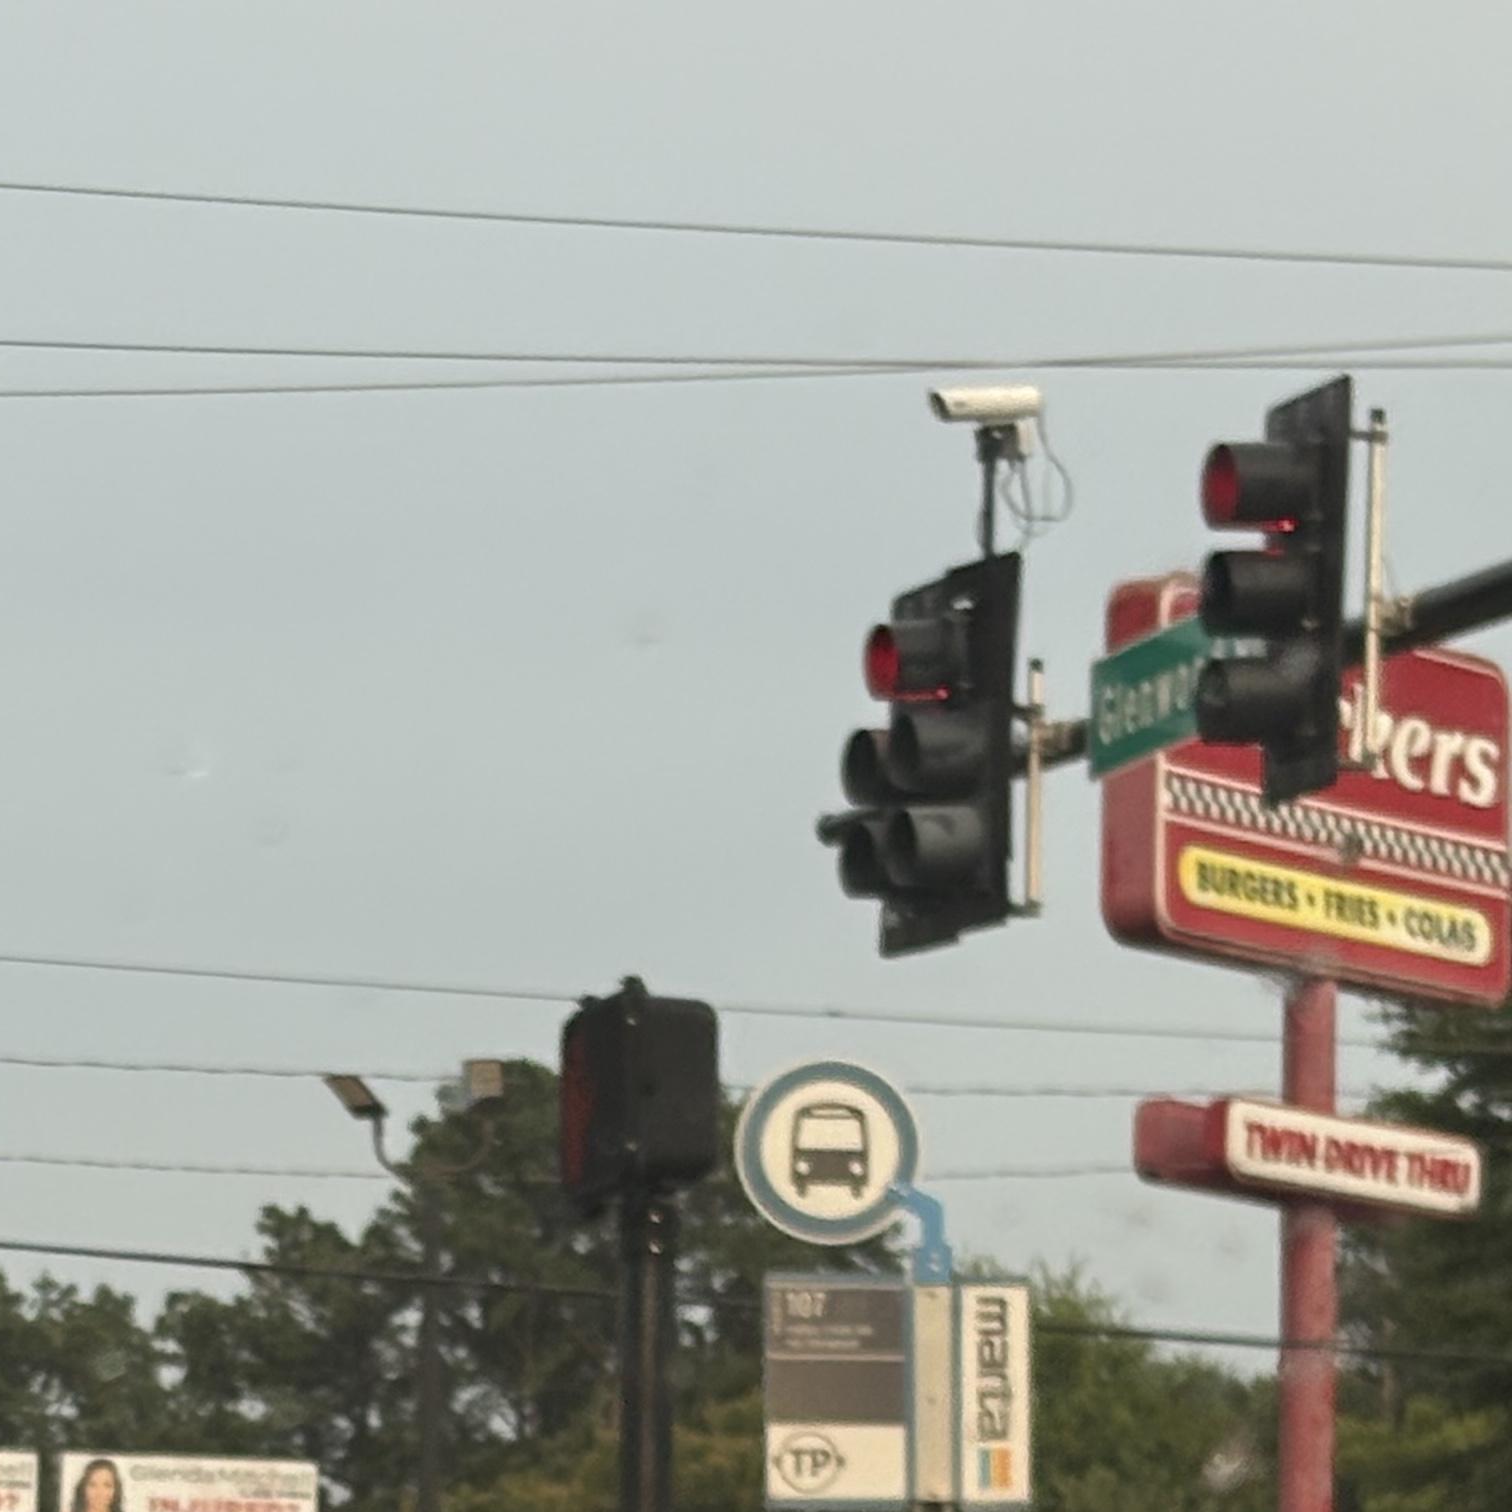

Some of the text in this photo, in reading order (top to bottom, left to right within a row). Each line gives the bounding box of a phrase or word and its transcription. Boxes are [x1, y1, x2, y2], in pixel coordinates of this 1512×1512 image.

[1339, 682, 1500, 808] kers
[1196, 861, 1476, 952] BURGERS FRIES COLAS
[1245, 1122, 1472, 1196] TWIN DRIVE THRU
[976, 1295, 1011, 1443] marta
[790, 1447, 831, 1478] TP
